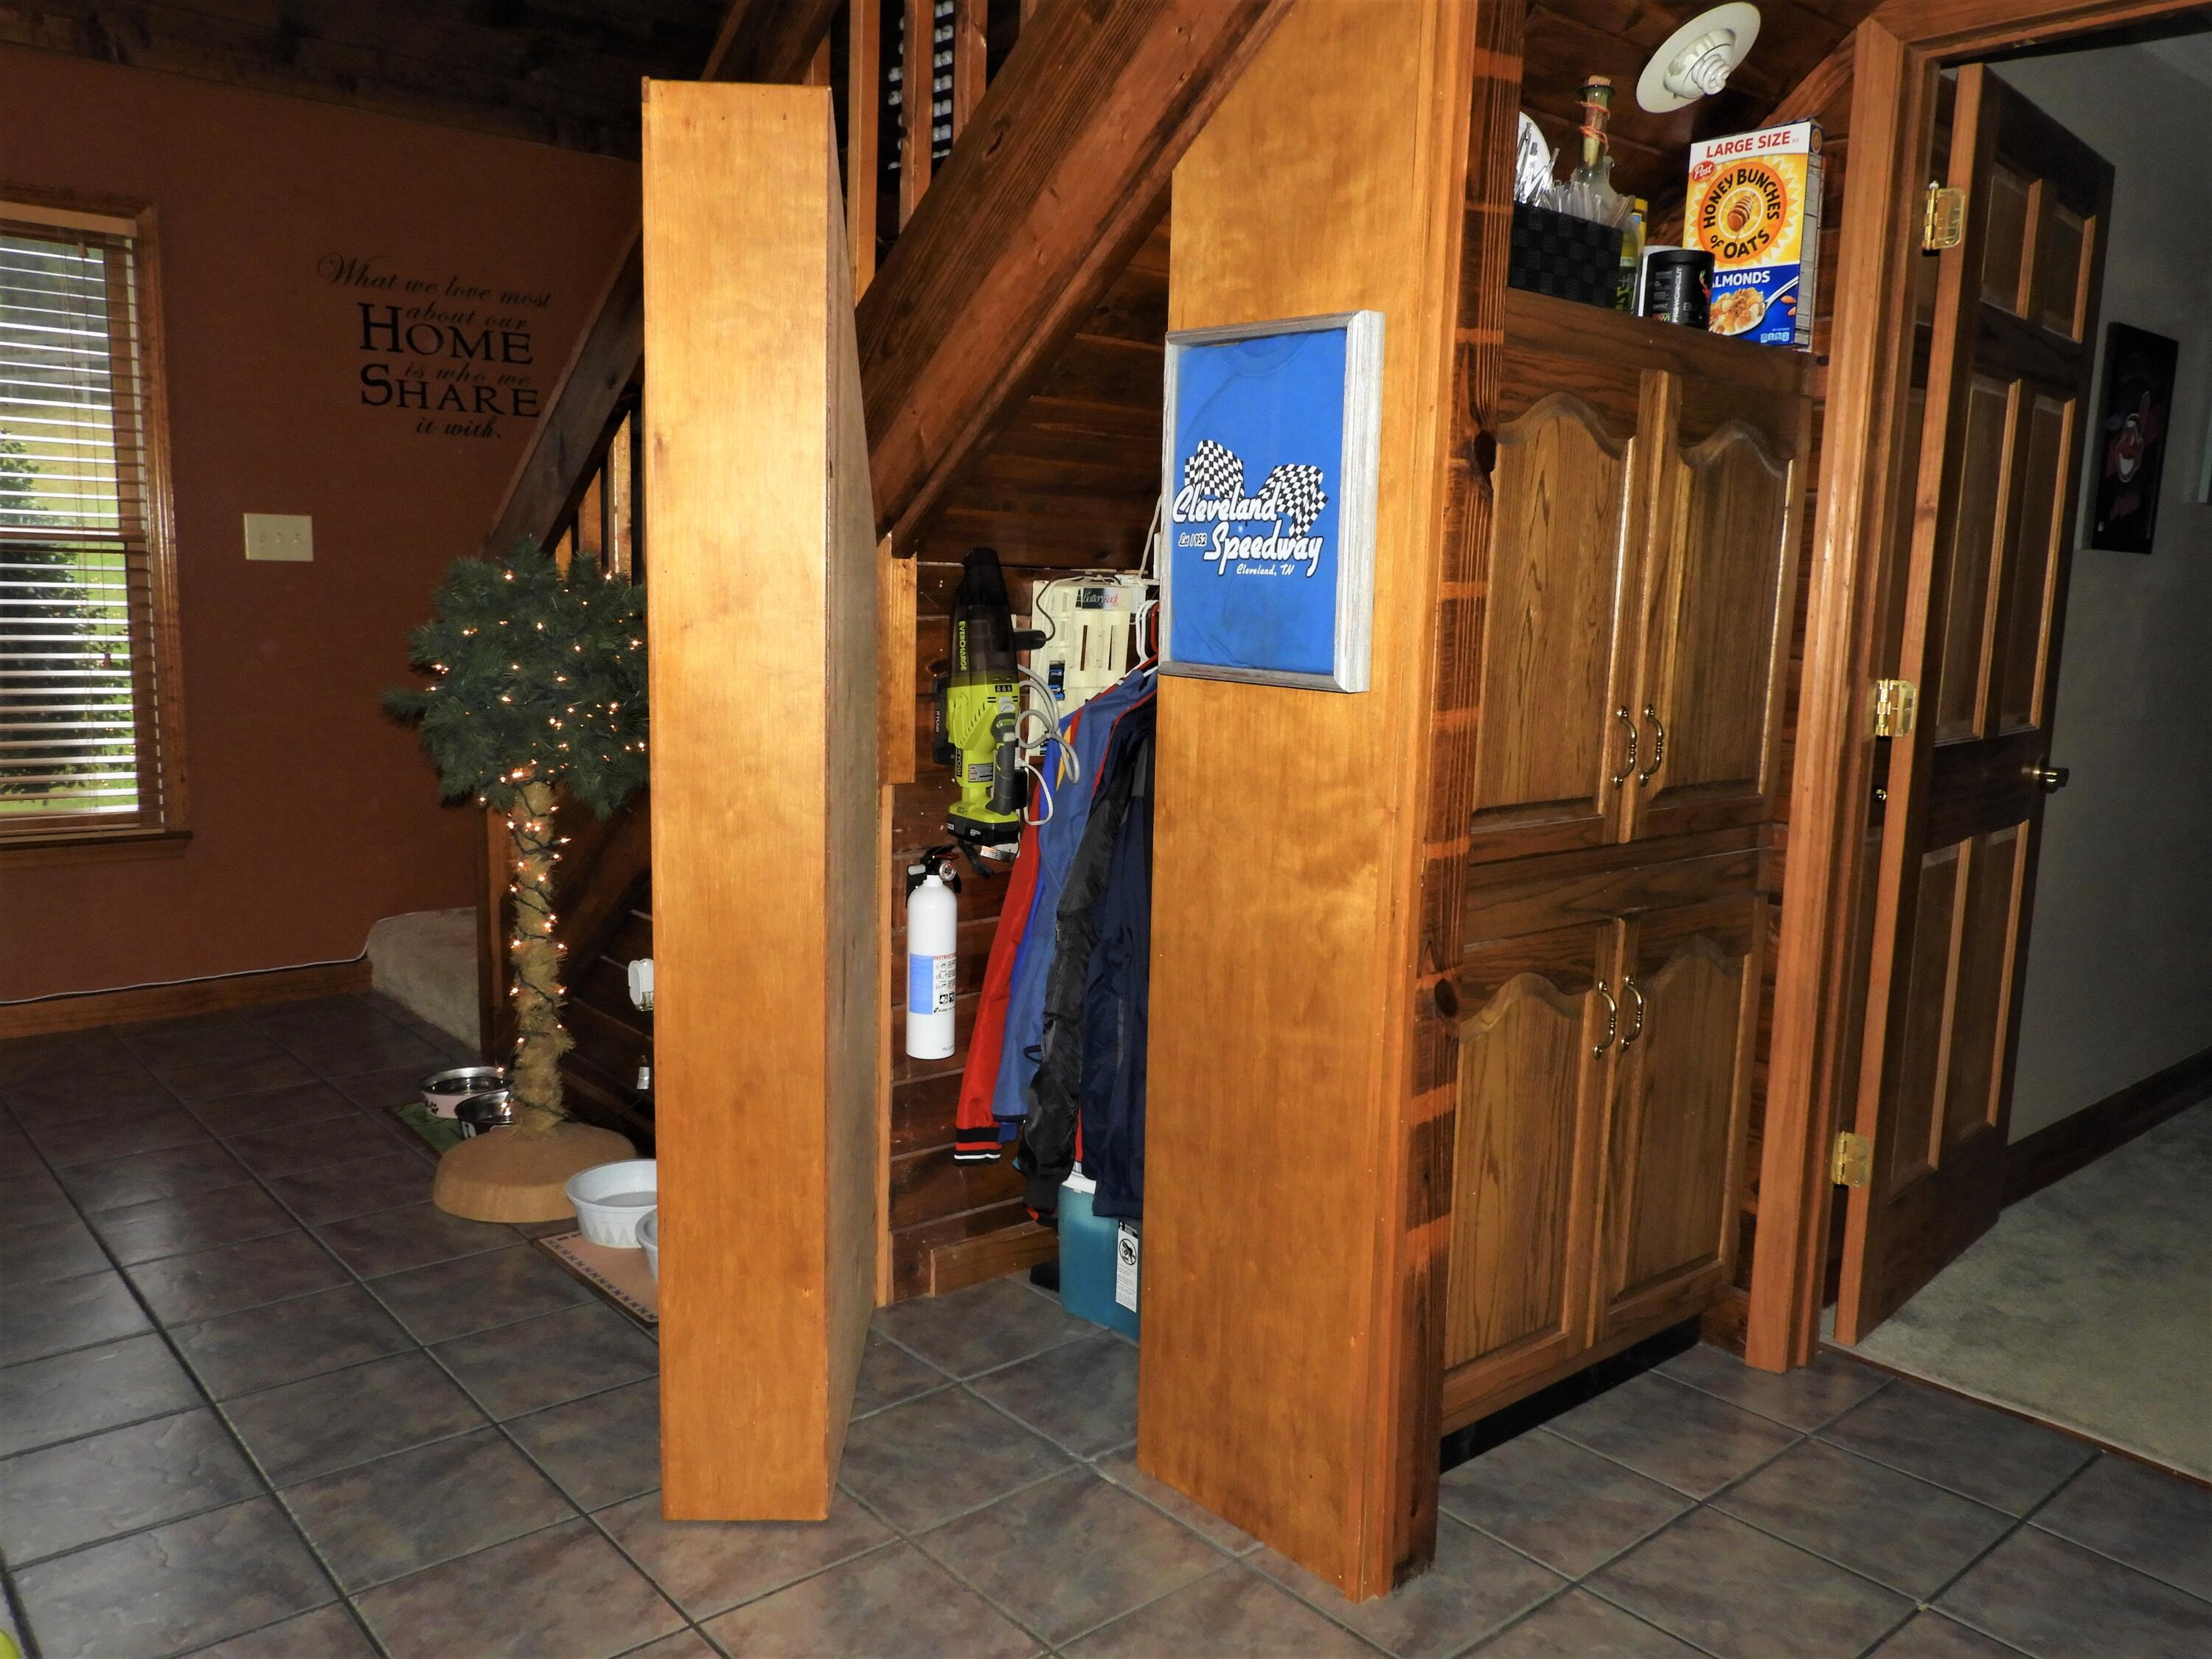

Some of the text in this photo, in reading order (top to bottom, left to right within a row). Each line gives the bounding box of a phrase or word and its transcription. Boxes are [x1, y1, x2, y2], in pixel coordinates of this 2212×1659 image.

[1705, 131, 1792, 159] LARGE SIZE
[1693, 163, 1713, 177] Post
[1703, 168, 1781, 229] HONEY BUNCHES
[1711, 228, 1770, 260] of OATS
[316, 252, 552, 308] What we love most
[1712, 270, 1770, 288] LMONDS
[406, 301, 529, 330] about our
[357, 302, 534, 365] HOME
[404, 362, 532, 387] is who we
[360, 364, 540, 418] SHARE
[416, 417, 435, 435] it
[1172, 481, 1283, 524] Cleveland
[1190, 532, 1207, 548] 1952
[1203, 518, 1324, 578] Speedway
[1236, 563, 1295, 577] Cleveland, TN
[959, 621, 967, 671] EVERCHARGE
